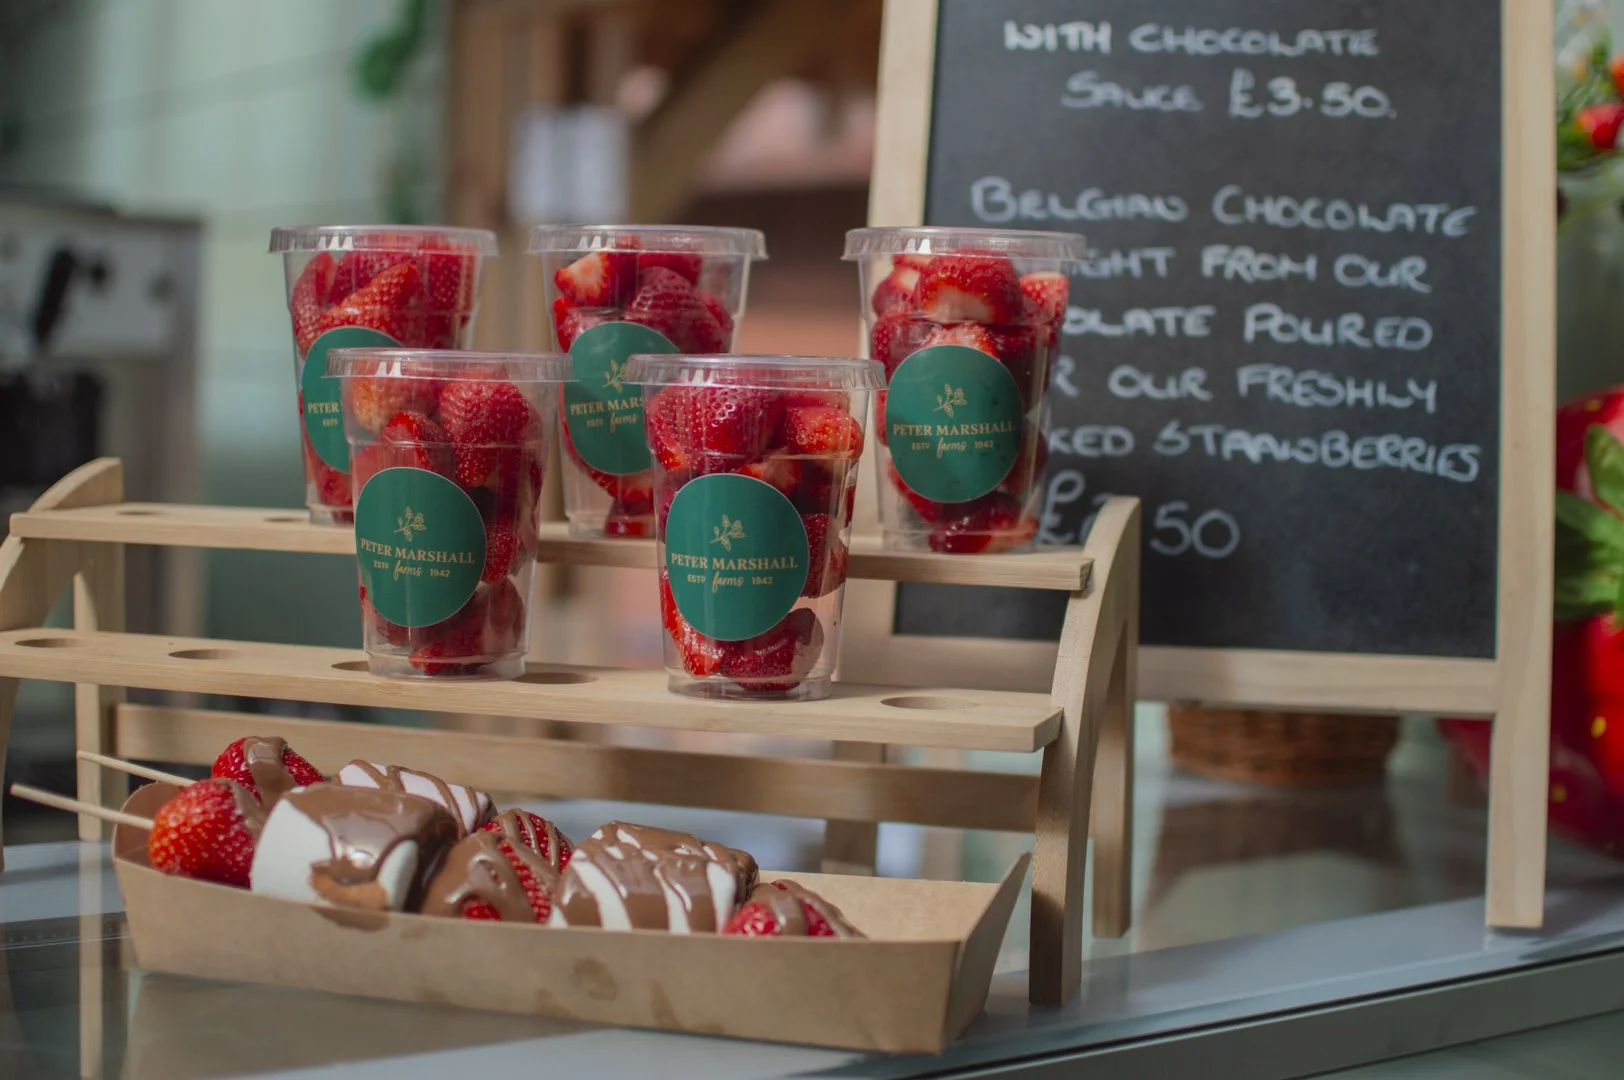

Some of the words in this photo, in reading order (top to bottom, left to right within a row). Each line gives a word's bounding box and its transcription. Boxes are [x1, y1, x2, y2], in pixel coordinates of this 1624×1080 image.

[1003, 20, 1113, 54] WITH
[1127, 22, 1381, 57] CHOCOLATE
[1060, 70, 1202, 111] SAUCE
[970, 175, 1187, 223] BELGIAN
[1212, 185, 1477, 237] CHOCOLATE
[1201, 244, 1319, 283] FROM
[1333, 253, 1431, 293] OUR
[1243, 302, 1434, 350] POURED
[1107, 365, 1212, 401] OUR
[1236, 363, 1438, 414] FRESHLY
[306, 401, 340, 415] PETER
[569, 400, 605, 416] PETER
[892, 423, 933, 437] PETER
[936, 420, 1016, 437] MARSHALL
[936, 437, 967, 460] farms
[1153, 420, 1481, 482] STRAWBERRIES
[359, 537, 392, 558] PETER
[395, 545, 476, 564] MARSHALL
[671, 552, 709, 569] PETER
[712, 556, 799, 571] MARSHALL
[393, 560, 423, 582] farms
[429, 568, 451, 578] 1942
[711, 571, 745, 594] farms
[752, 576, 774, 586] 1942
